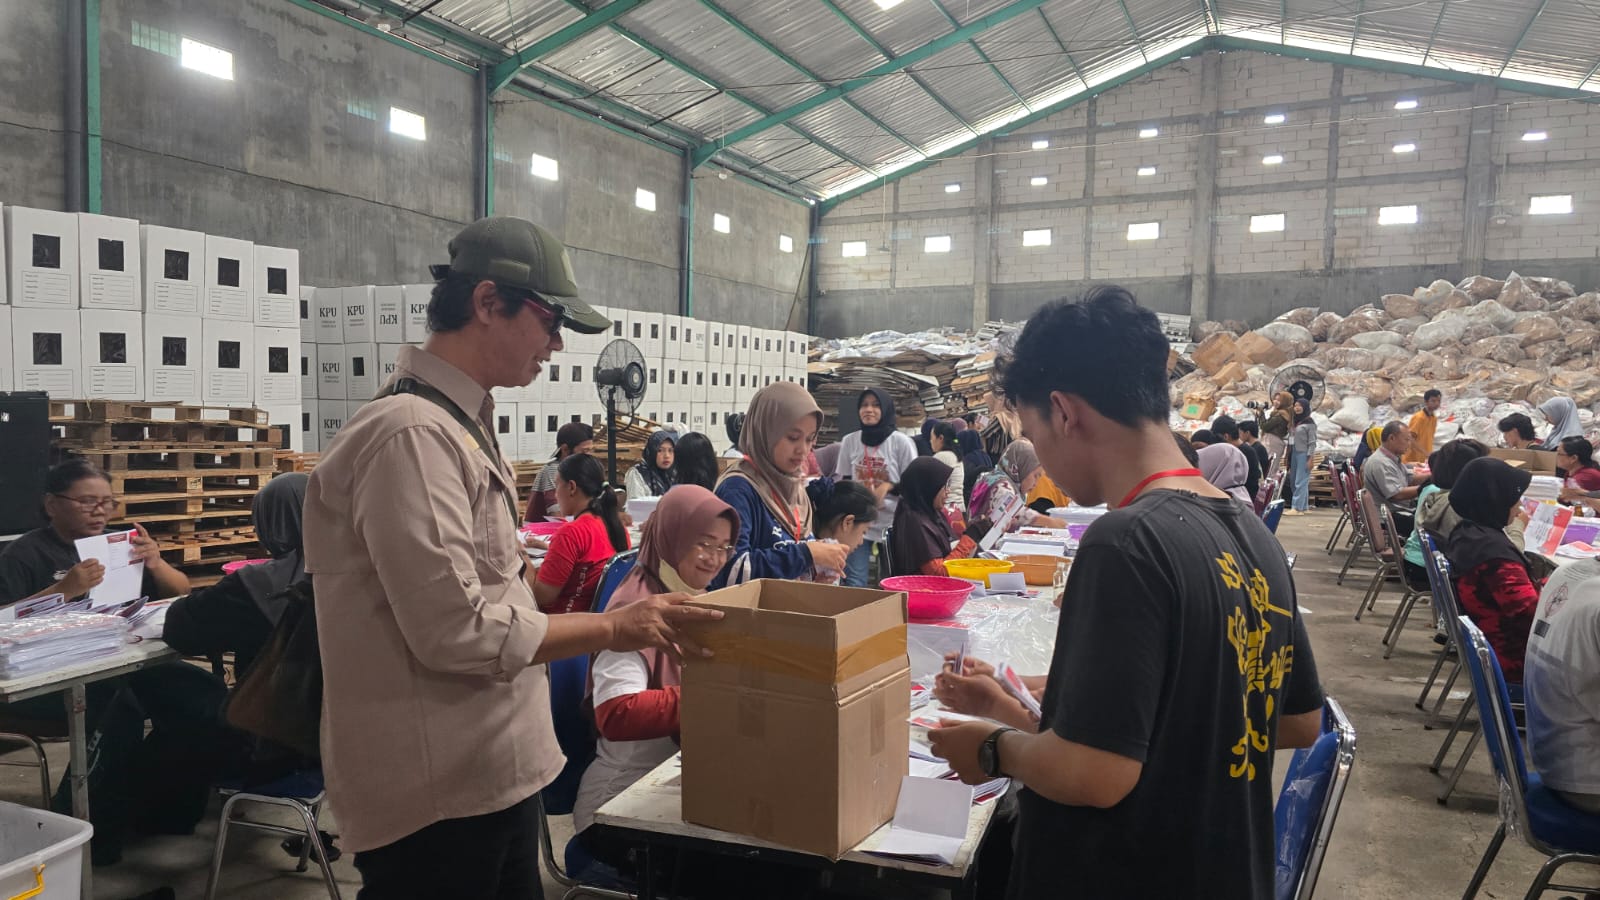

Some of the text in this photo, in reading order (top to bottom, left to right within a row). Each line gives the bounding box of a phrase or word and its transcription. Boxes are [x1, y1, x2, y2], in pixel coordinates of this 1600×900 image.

[319, 307, 337, 318] KPU
[347, 304, 365, 317] KPU
[379, 314, 398, 325] KPU
[322, 362, 340, 373] KPU
[323, 418, 341, 429] KPU
